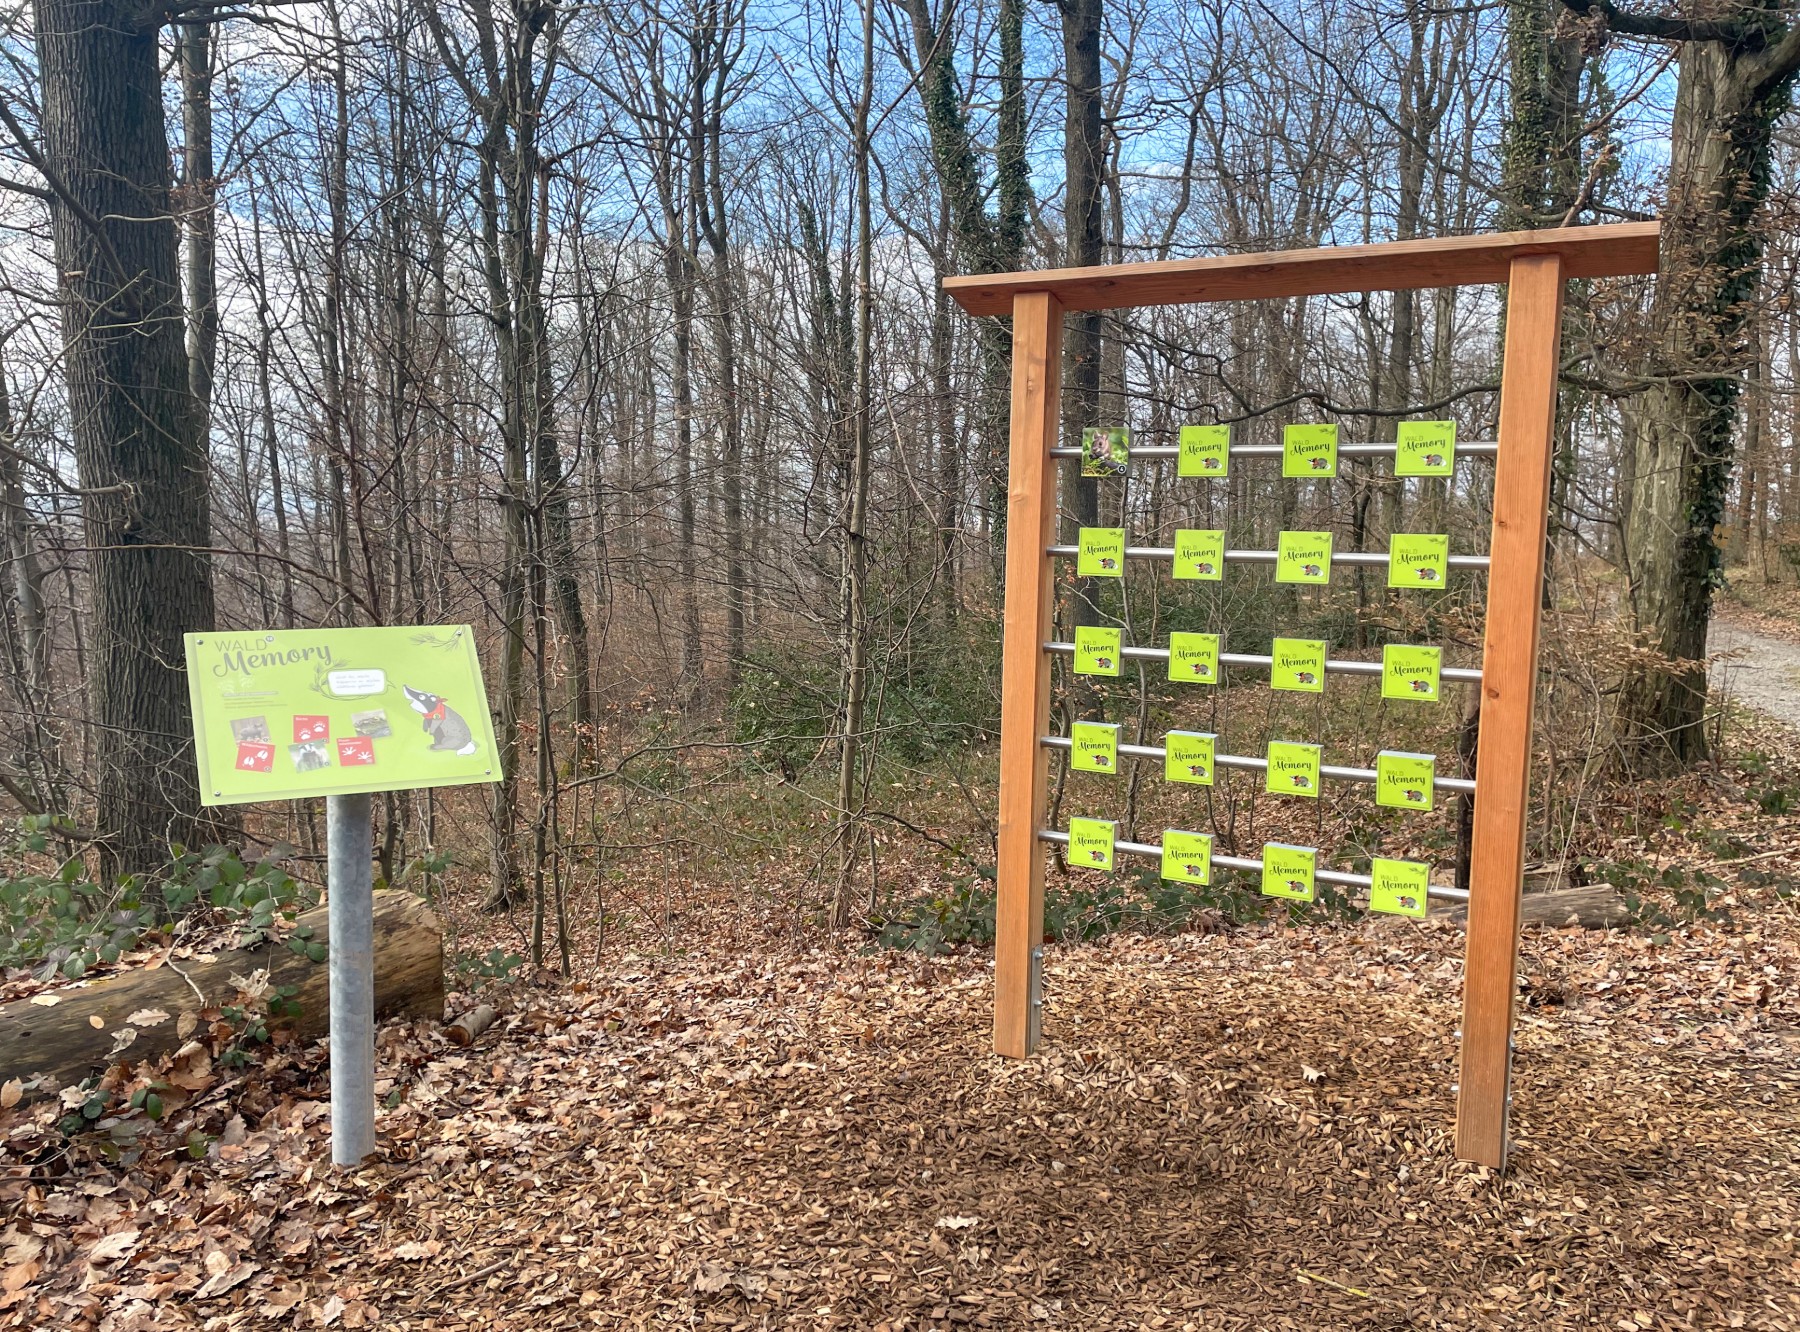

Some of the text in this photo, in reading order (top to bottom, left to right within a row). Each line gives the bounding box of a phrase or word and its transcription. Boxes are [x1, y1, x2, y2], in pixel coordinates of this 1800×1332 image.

[1185, 444, 1222, 456] Memory
[1290, 443, 1330, 455] Memory
[1402, 440, 1445, 451] Memory
[1084, 545, 1118, 555] Memory
[1180, 549, 1216, 559] Memory
[1284, 550, 1323, 561] Memory
[1397, 553, 1440, 564] Memory
[214, 638, 268, 652] WALD
[1080, 644, 1113, 654] Memory
[1175, 649, 1211, 659] Memory
[213, 646, 332, 678] Memory
[1278, 657, 1317, 668] Memory
[1390, 665, 1432, 676] Memory
[1077, 741, 1110, 751] Memory
[1171, 752, 1206, 762] Memory
[1273, 760, 1311, 771] Memory
[1384, 774, 1425, 785] Memory
[1074, 837, 1107, 847] Memory
[1168, 851, 1203, 861] Memory
[1269, 866, 1307, 876] Memory
[1378, 880, 1419, 891] Memory
